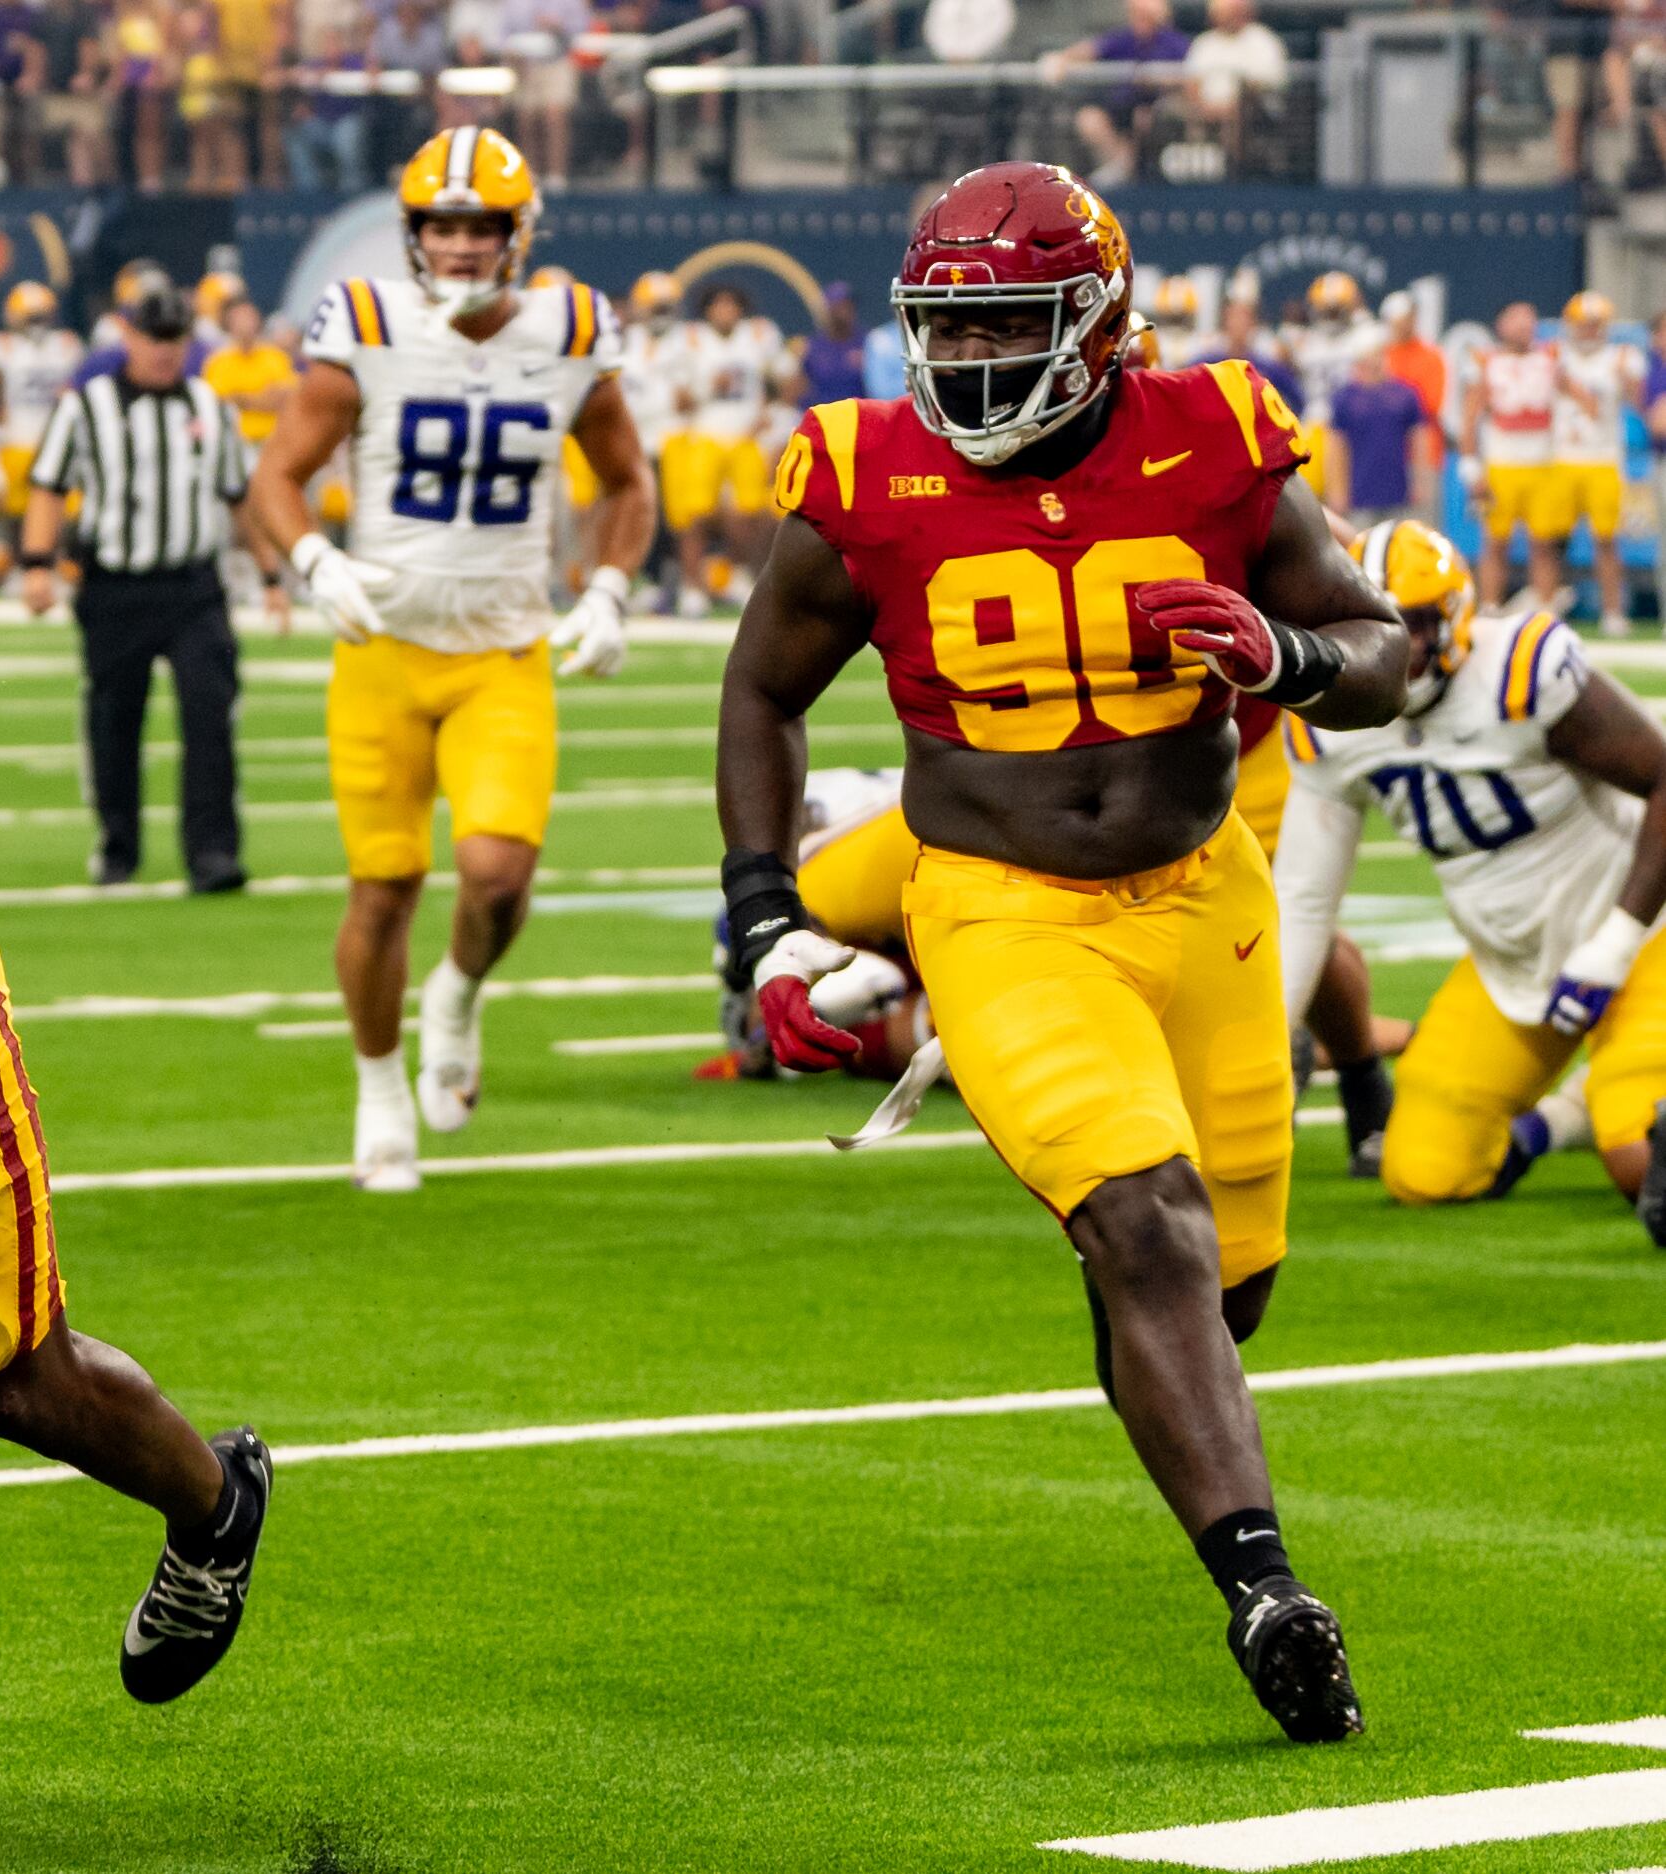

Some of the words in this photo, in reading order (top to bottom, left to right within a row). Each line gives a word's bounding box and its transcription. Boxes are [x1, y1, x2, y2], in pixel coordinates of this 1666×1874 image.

[391, 398, 551, 525] 86
[926, 535, 1209, 752] 90
[1370, 764, 1538, 856] 70
